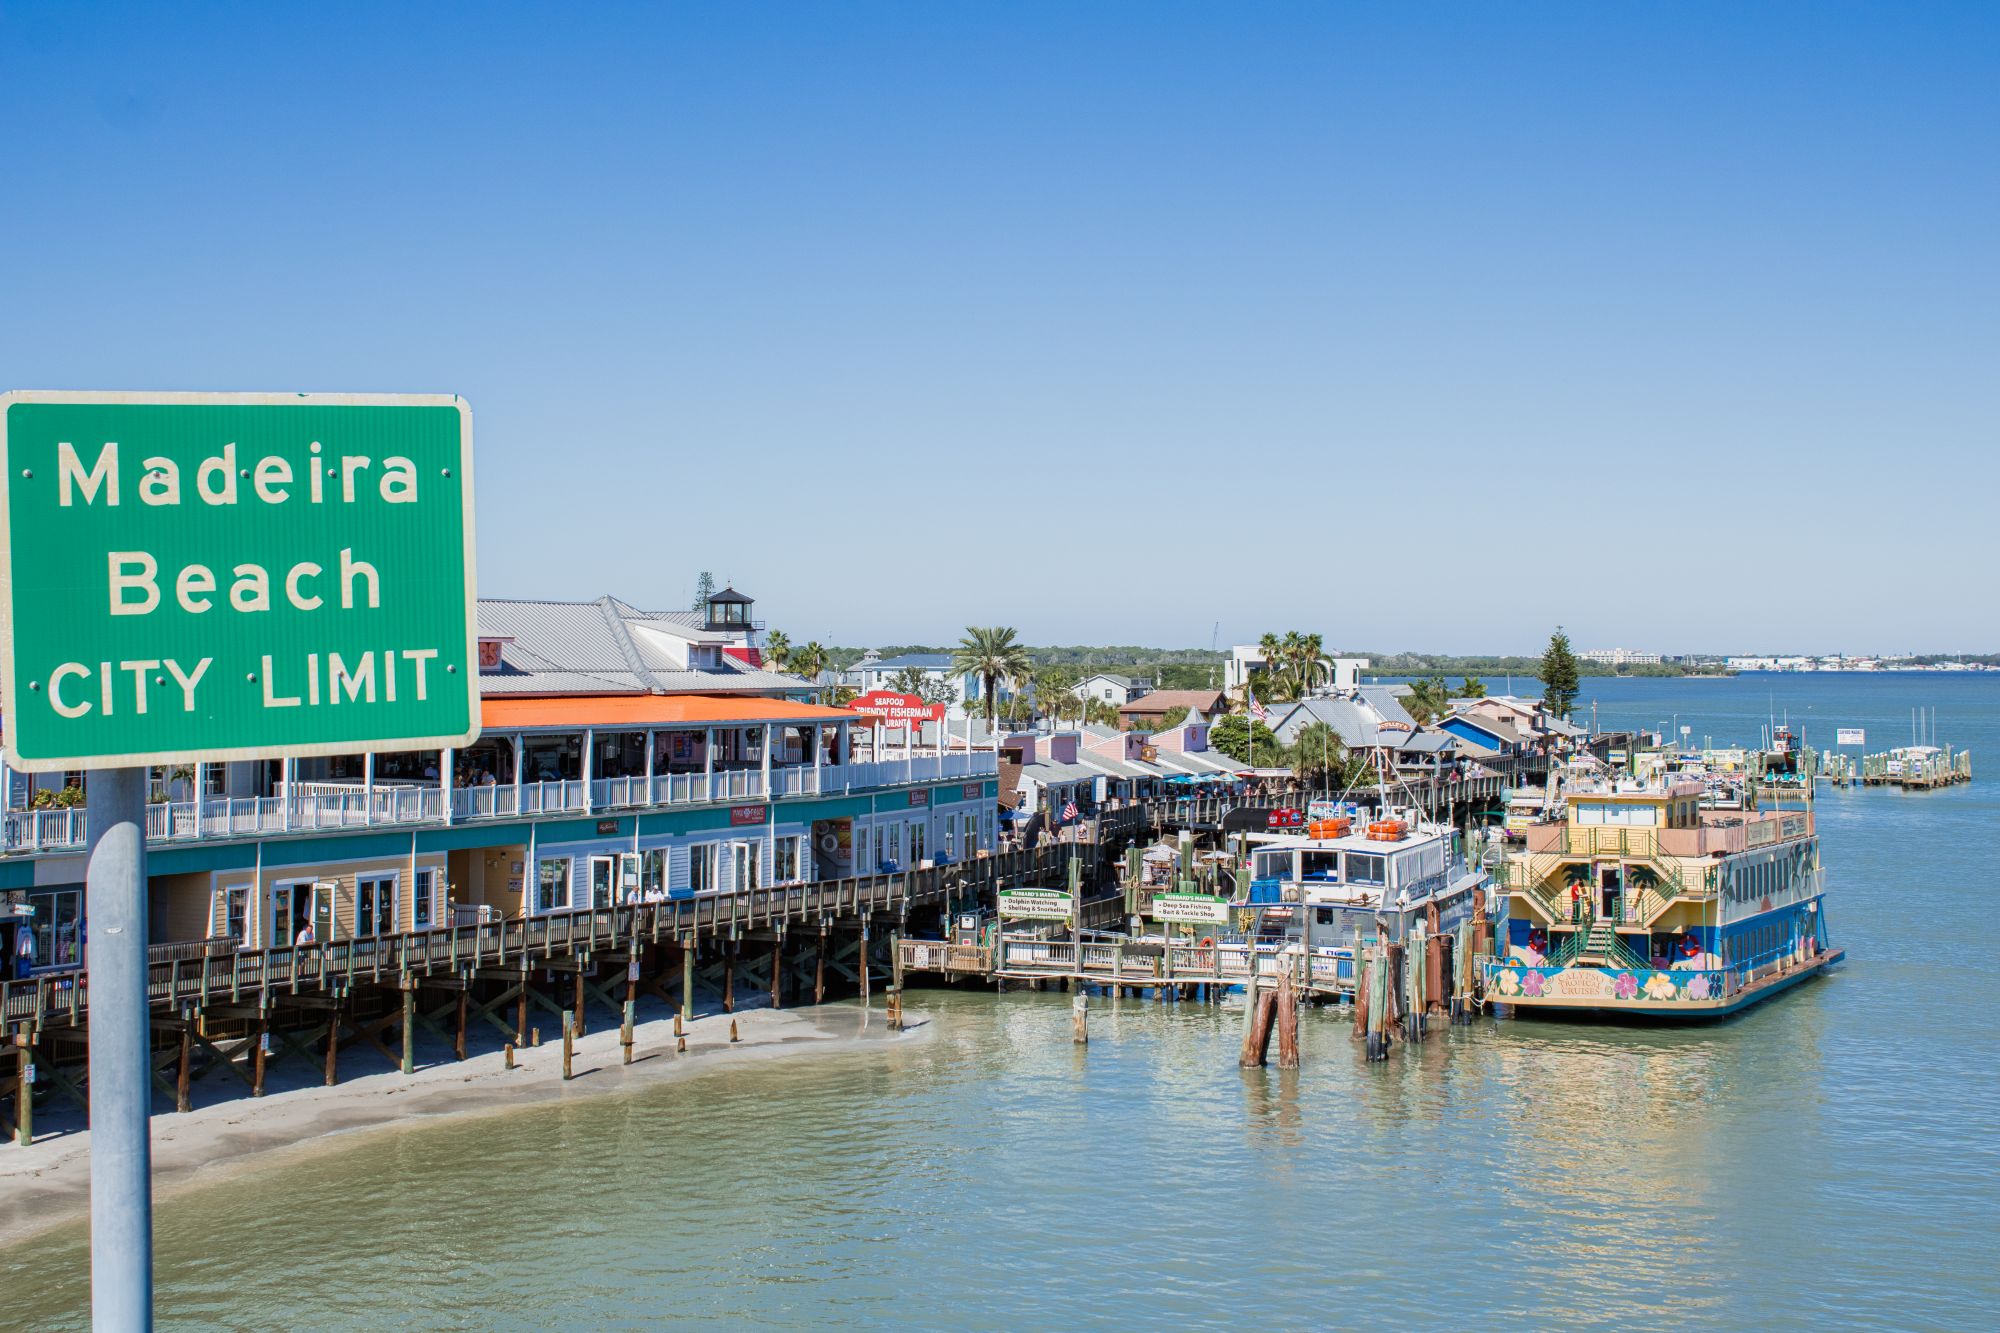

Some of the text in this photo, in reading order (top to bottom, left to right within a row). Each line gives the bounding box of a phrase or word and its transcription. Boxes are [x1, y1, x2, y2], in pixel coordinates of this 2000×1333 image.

[57, 441, 418, 507] Madeira
[108, 548, 380, 616] Beach
[48, 649, 438, 718] CITY LIMIT
[874, 698, 905, 706] SEAFOOD
[890, 708, 932, 717] FISHERMAN
[886, 719, 907, 727] URANT
[1558, 972, 1603, 983] CALYPSO
